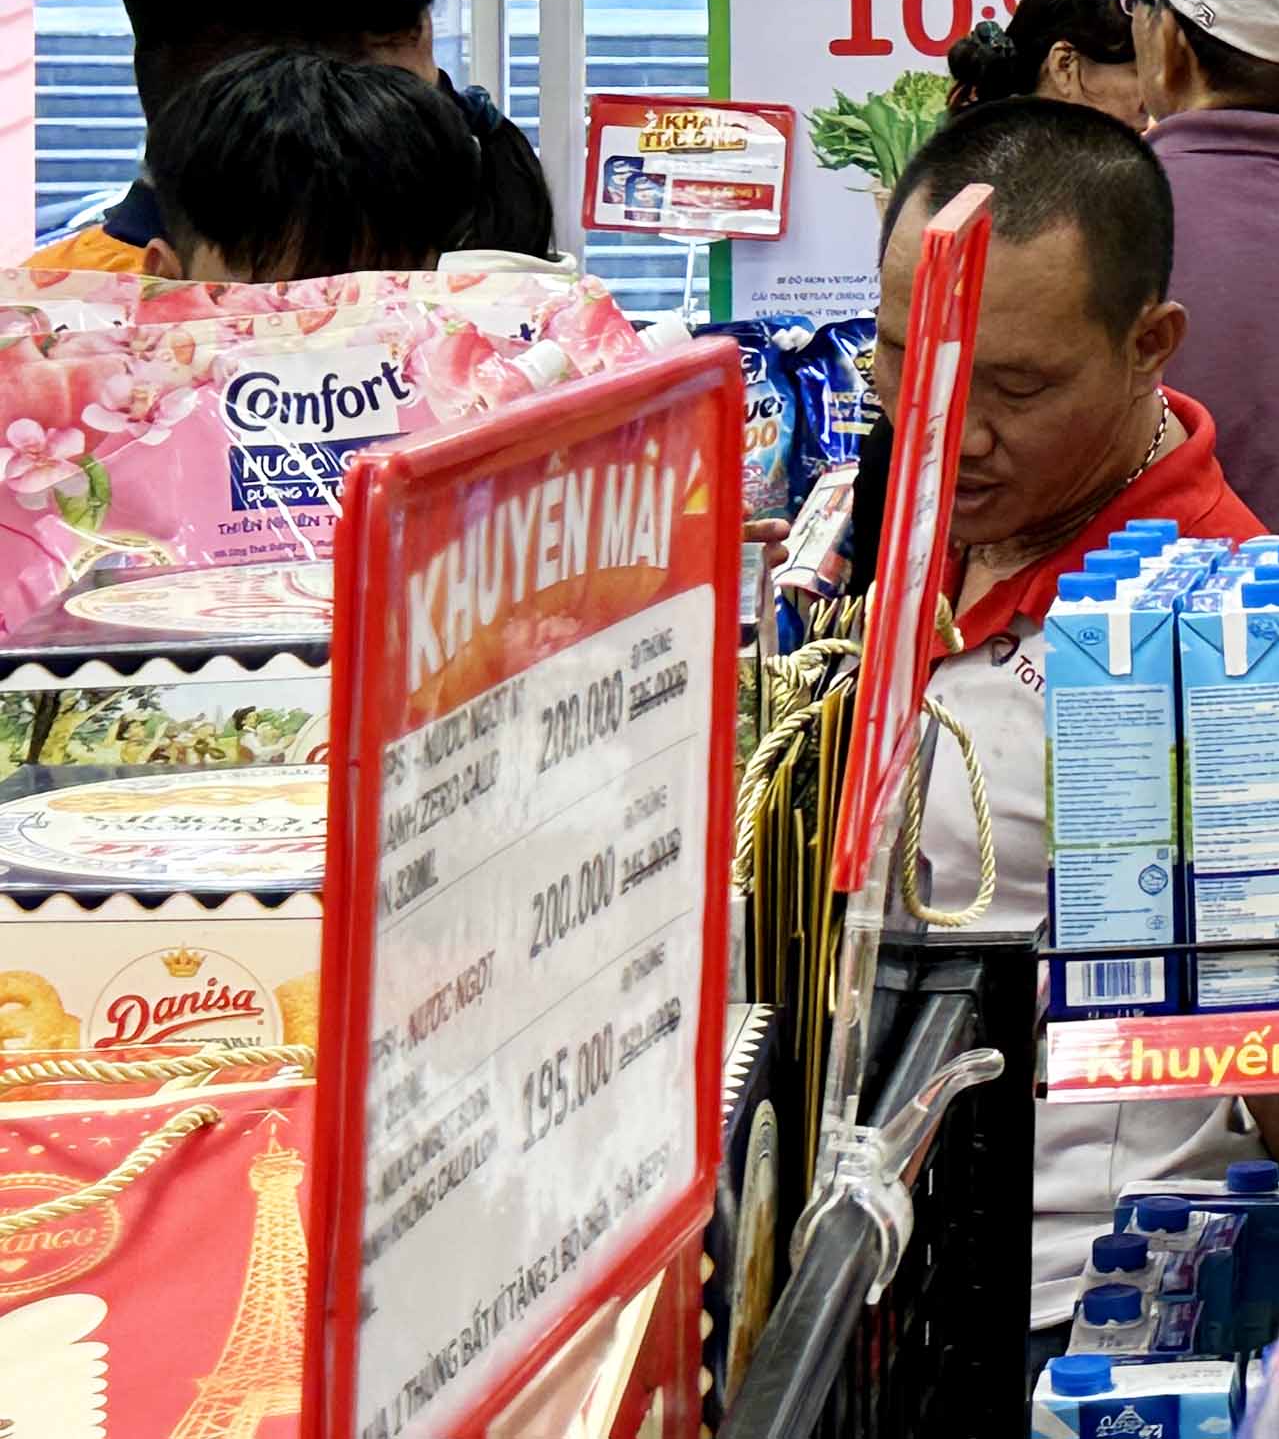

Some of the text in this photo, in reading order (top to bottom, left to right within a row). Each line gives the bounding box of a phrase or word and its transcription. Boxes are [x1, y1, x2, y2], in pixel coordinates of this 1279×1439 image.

[225, 361, 411, 434] Comfort
[1013, 655, 1045, 694] TOT
[538, 668, 624, 774] 200.000
[529, 844, 616, 960] 200.000
[95, 976, 265, 1049] Danisa
[522, 1021, 614, 1153] 195.000
